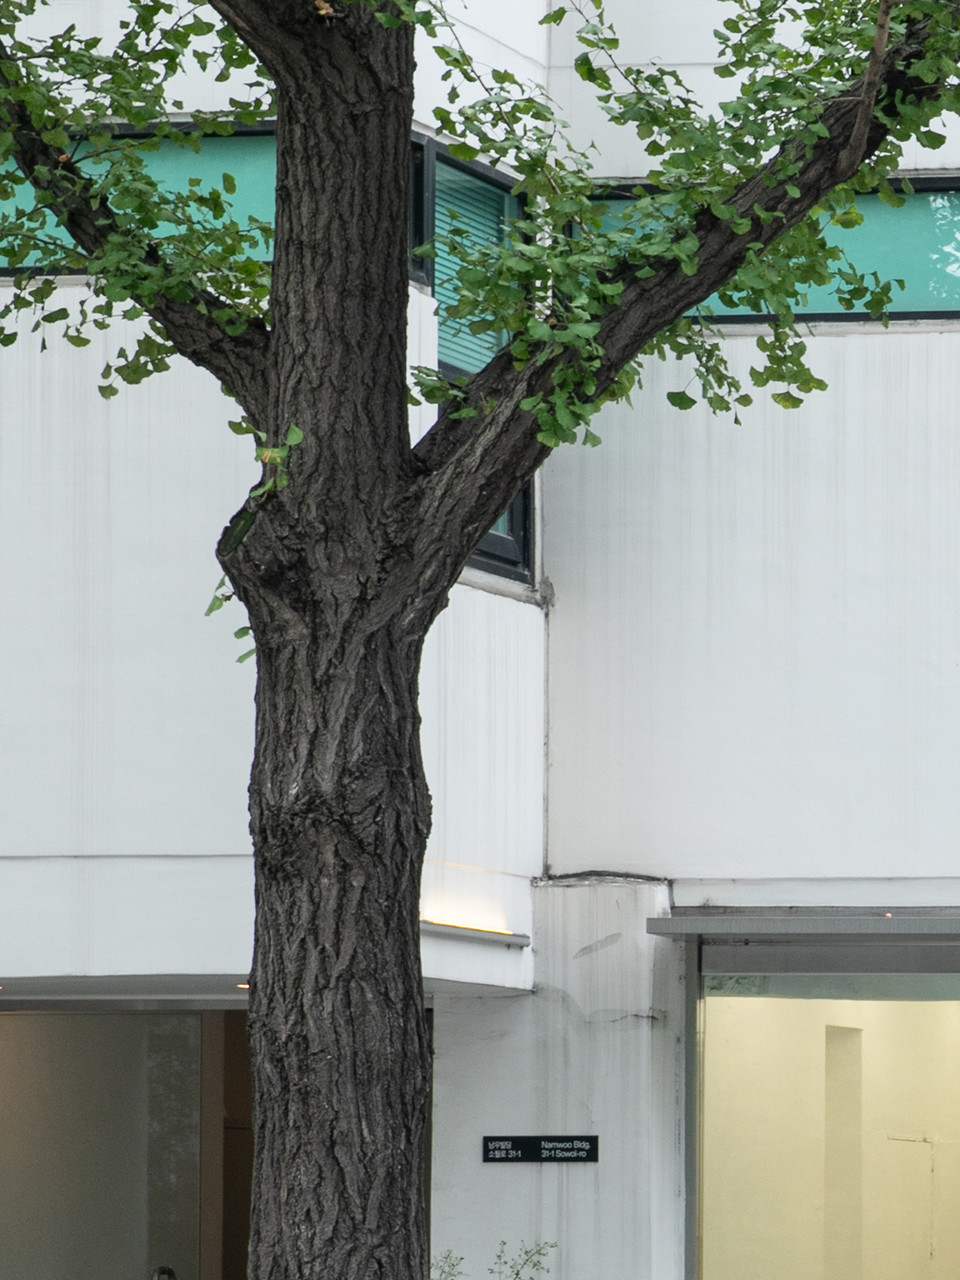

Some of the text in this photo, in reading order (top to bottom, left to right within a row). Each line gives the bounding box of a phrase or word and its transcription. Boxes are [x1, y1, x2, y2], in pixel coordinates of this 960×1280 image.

[541, 1140, 591, 1150] Namwoo Bldg.
[508, 1150, 521, 1158] 31-1
[541, 1149, 587, 1158] 31-1 Sowol-ro
